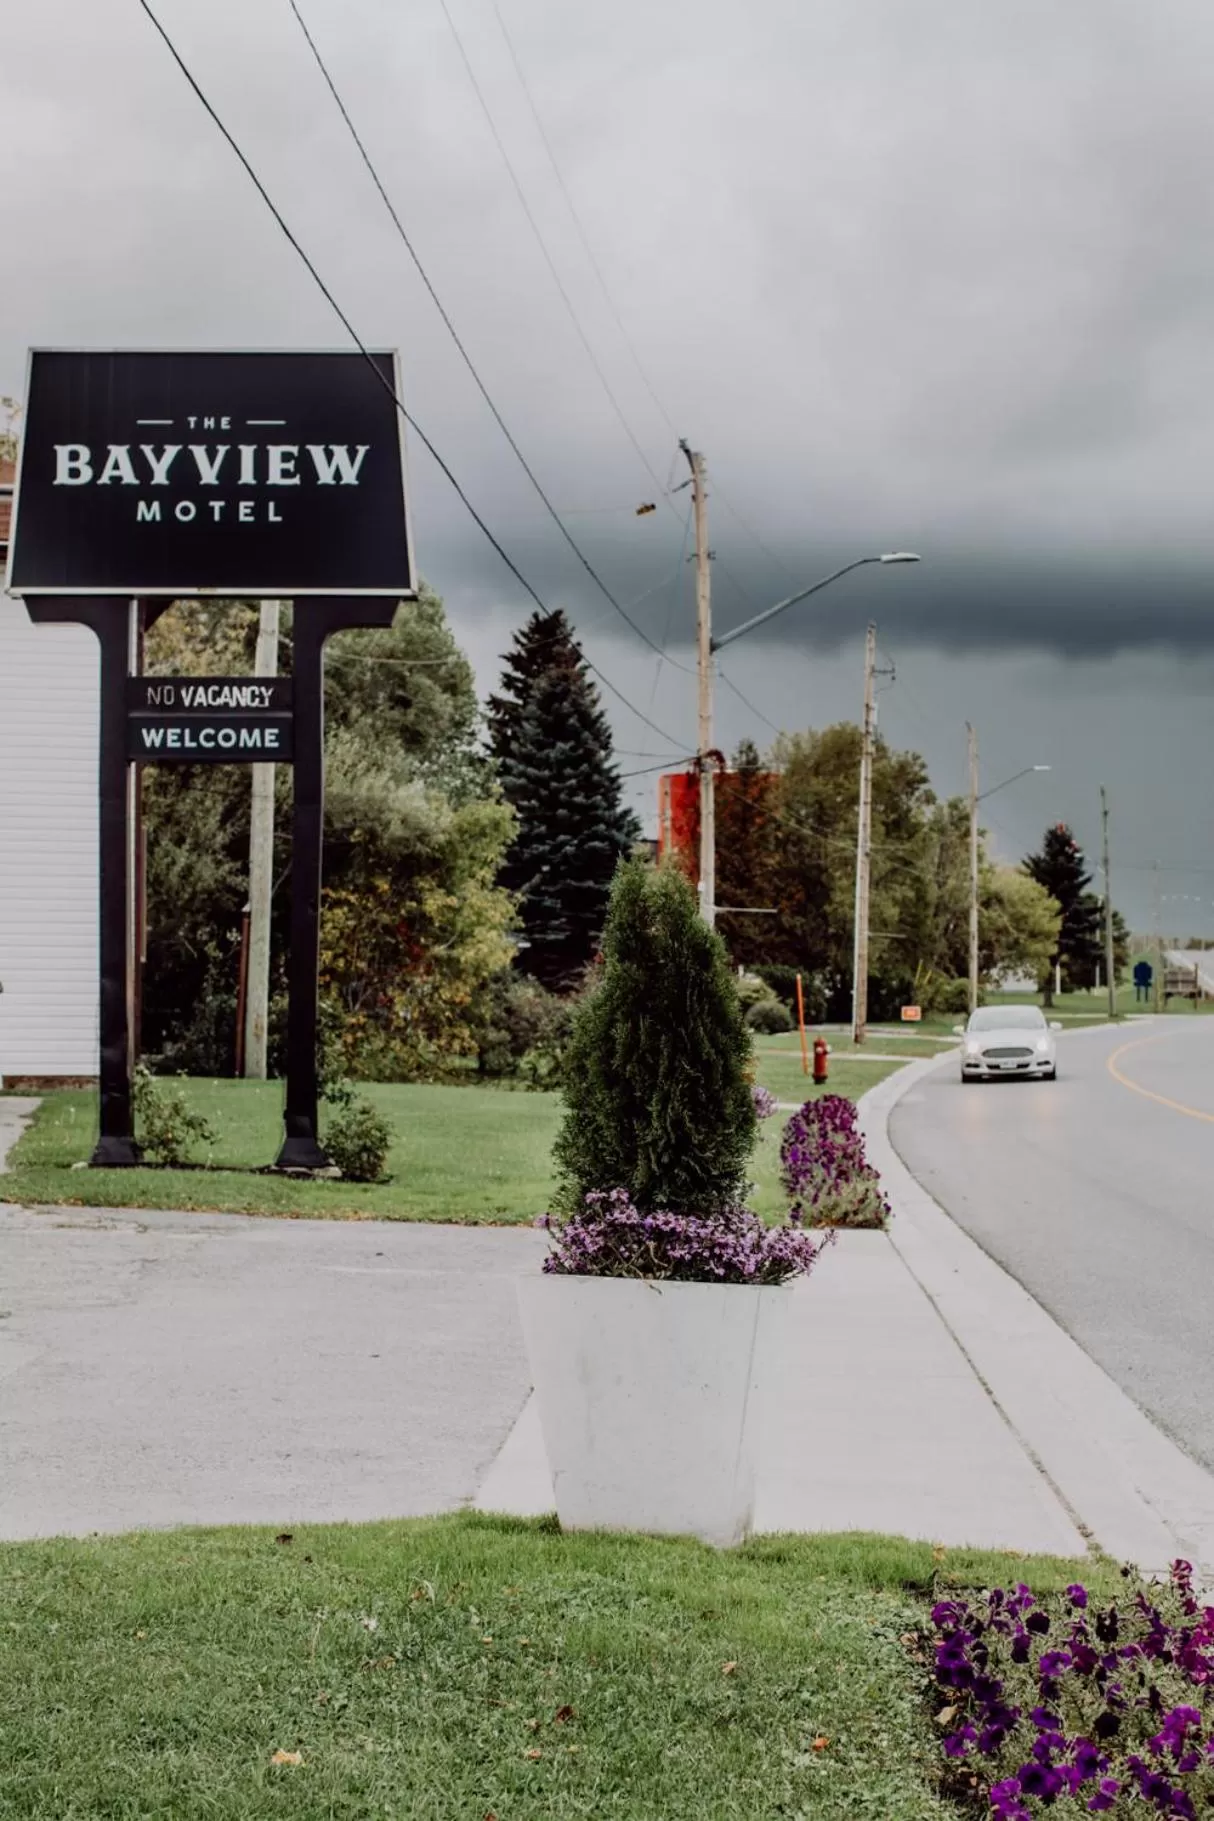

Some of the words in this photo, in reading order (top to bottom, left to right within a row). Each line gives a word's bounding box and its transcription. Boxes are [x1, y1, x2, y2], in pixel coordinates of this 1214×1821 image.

[187, 416, 231, 429] THE
[52, 444, 370, 486] BAYVIEW
[136, 501, 283, 523] MOTEL
[146, 686, 175, 705] NO
[180, 685, 274, 707] VACANCY
[141, 727, 280, 748] WELCOME
